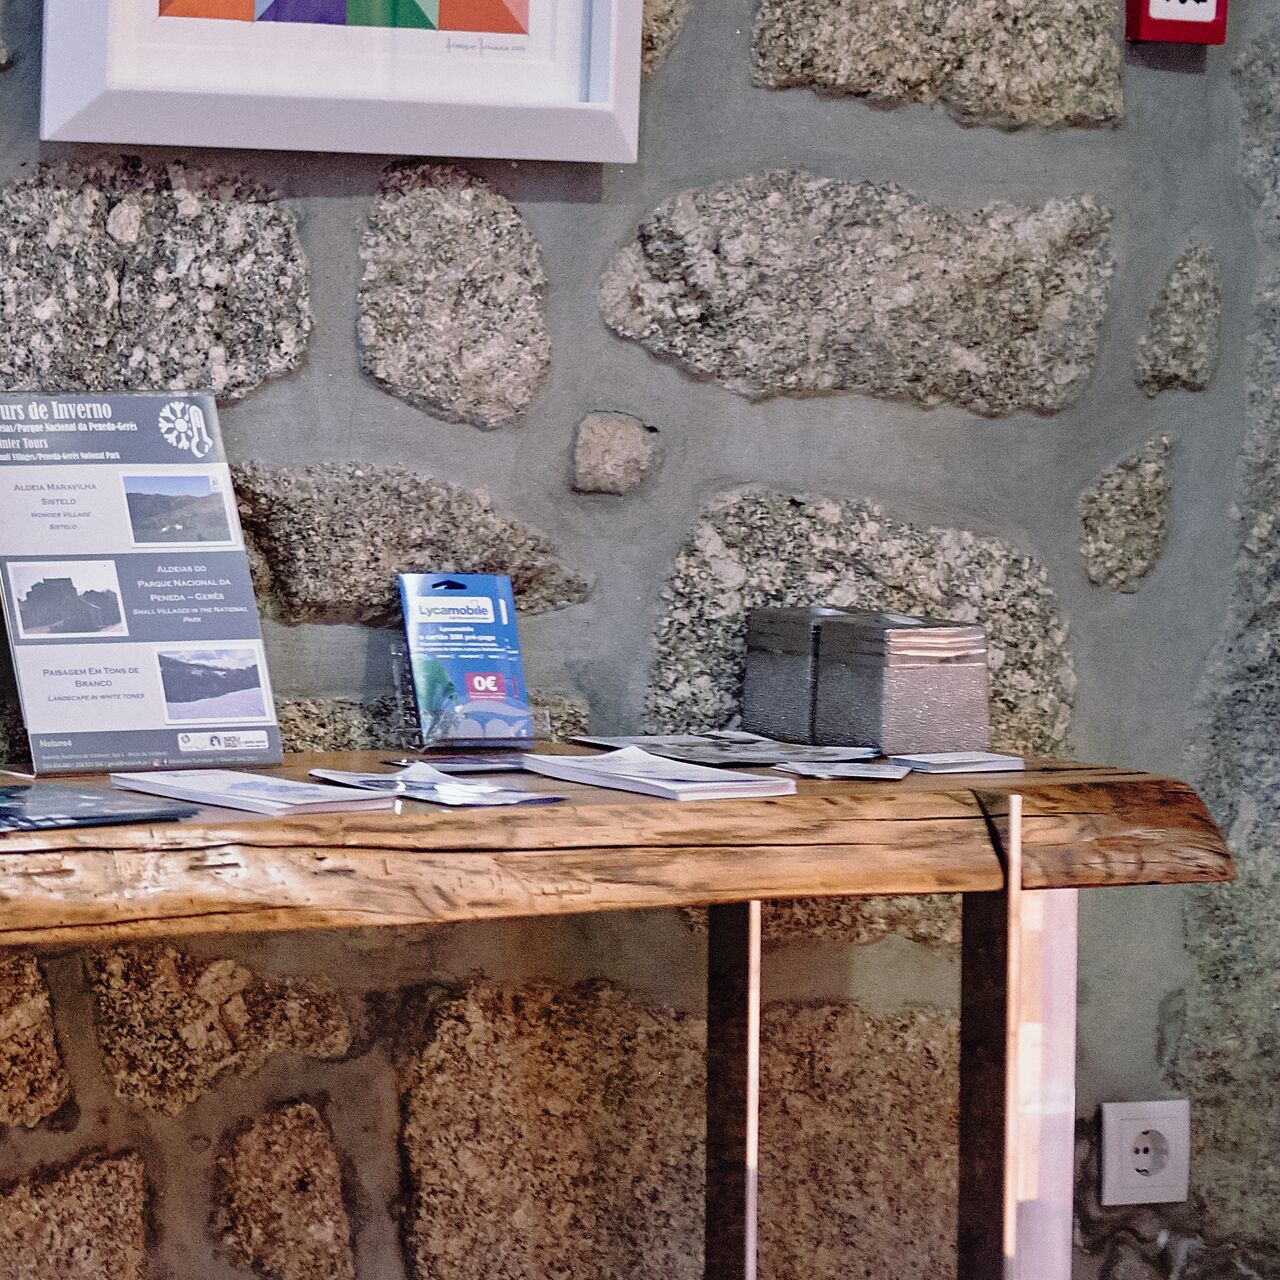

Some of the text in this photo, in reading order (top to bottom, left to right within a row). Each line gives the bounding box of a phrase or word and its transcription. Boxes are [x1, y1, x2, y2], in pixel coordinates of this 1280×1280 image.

[28, 401, 48, 420] de
[51, 401, 112, 419] Inverno
[44, 422, 77, 432] Nacional
[77, 422, 88, 431] da
[22, 437, 49, 449] Tours
[418, 605, 489, 617] Lycamobile
[473, 675, 498, 692] 0€
